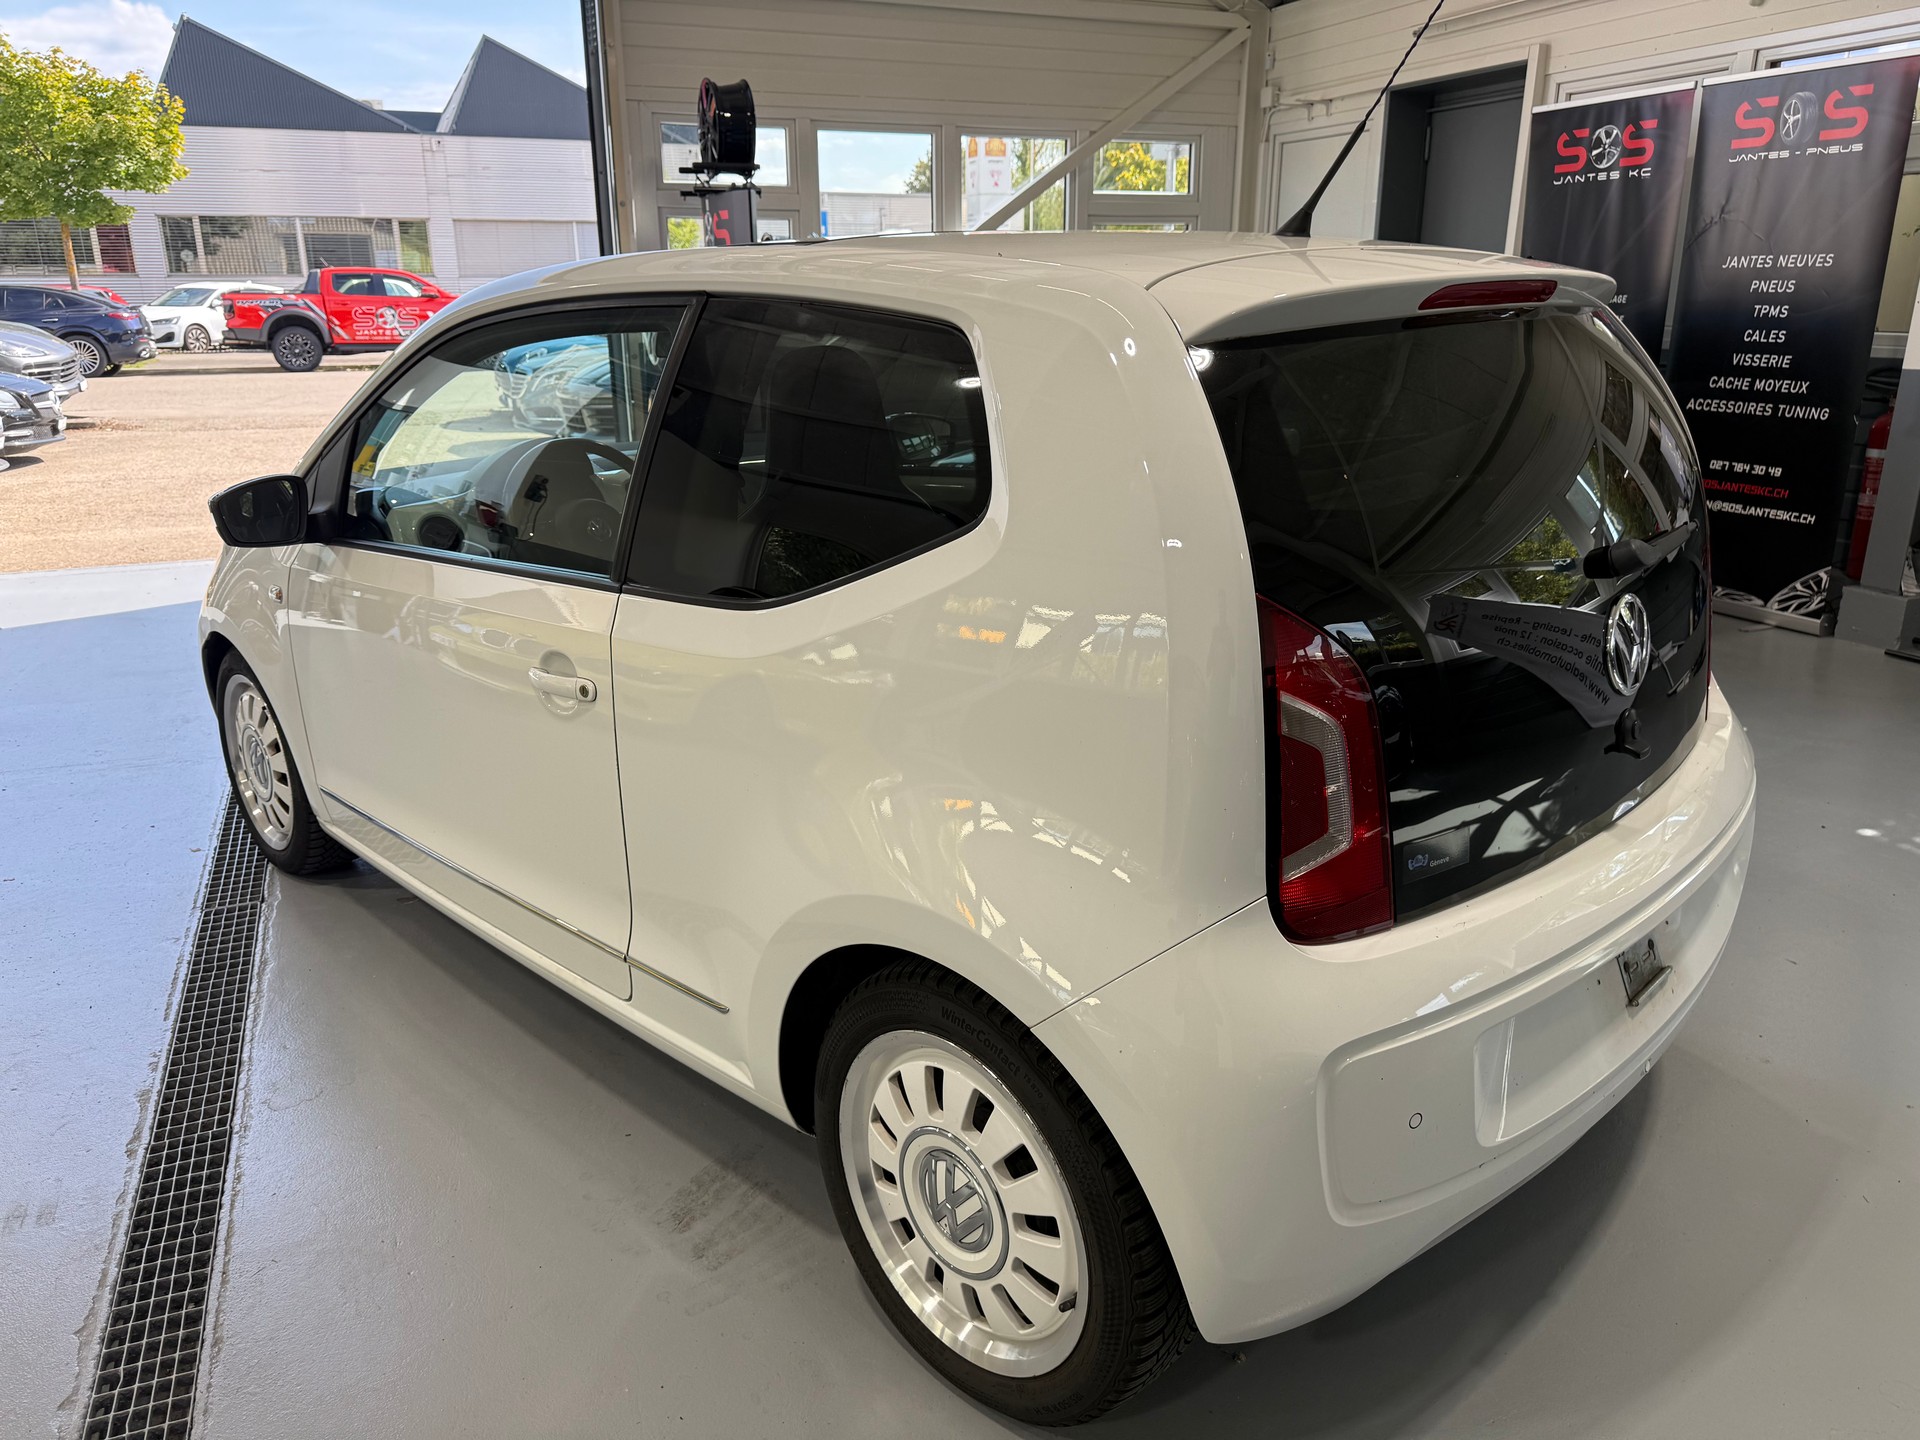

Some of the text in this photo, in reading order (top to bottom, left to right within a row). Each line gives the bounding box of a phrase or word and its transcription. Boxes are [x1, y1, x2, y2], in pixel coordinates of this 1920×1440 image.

[1728, 149, 1790, 163] JANTES
[1805, 143, 1863, 156] PNEUS
[1553, 167, 1652, 185] JANTES KC
[1722, 253, 1834, 269] JANTES NEUVES
[1750, 280, 1795, 293] PNEUS
[1753, 305, 1789, 318] TPMS
[1743, 329, 1786, 343] CALES
[1732, 353, 1792, 368] VISSERIE
[1709, 376, 1810, 395] CACHE MOYEUX
[1686, 398, 1830, 421] ACCESSOIRES TUNING
[1709, 459, 1729, 470] 027
[1732, 461, 1750, 473] 764
[1752, 464, 1766, 475] 30
[1706, 499, 1816, 525] N@SOSJANTESKC.CH
[941, 1006, 1021, 1077] WinterContact
